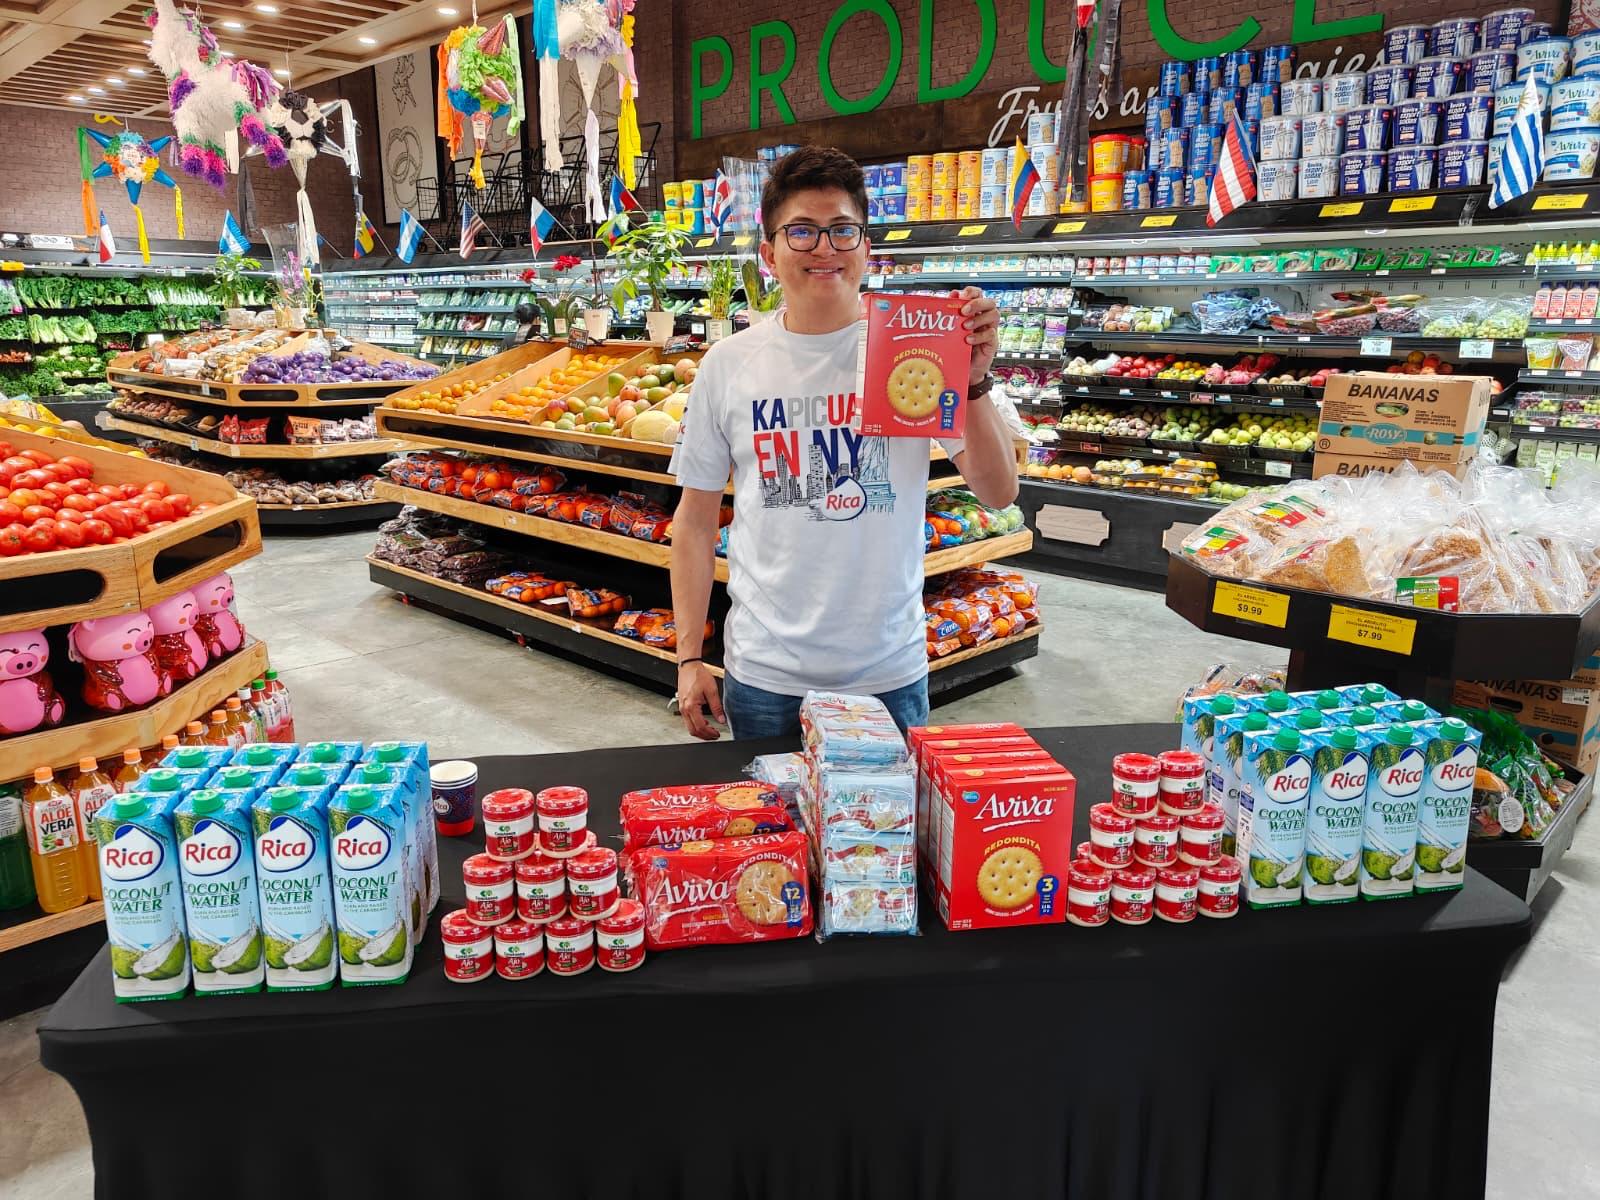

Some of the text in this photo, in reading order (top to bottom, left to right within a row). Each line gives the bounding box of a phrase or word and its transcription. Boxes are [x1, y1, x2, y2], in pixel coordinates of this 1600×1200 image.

[691, 0, 1384, 140] PRODU
[885, 303, 956, 332] Aviva
[893, 347, 944, 366] REDONDITA
[944, 392, 955, 406] 3
[1347, 383, 1440, 402] BANANAS
[1369, 428, 1401, 441] ROSY
[753, 427, 864, 479] EN NY
[826, 493, 861, 511] Rica
[1237, 603, 1263, 616] $9.99
[1357, 629, 1382, 641] $7.99
[1467, 680, 1560, 701] ANANAS
[1330, 772, 1366, 790] Rica
[1388, 767, 1422, 785] Rica
[1440, 764, 1474, 780] Rica
[1273, 772, 1309, 793] Rica
[973, 792, 1054, 820] Aviva
[1372, 801, 1417, 814] COCON
[1424, 796, 1469, 808] COCON
[41, 807, 72, 824] ALOE
[1259, 807, 1306, 820] COCON
[1315, 805, 1362, 818] COCON
[40, 817, 75, 835] VERA
[647, 825, 707, 845] Aviva
[185, 843, 232, 863] Rica
[261, 838, 306, 859] Rica
[337, 838, 382, 858] Rica
[984, 836, 1040, 856] REDONDITA
[106, 848, 153, 868] Rica
[340, 887, 388, 901] WATER
[650, 877, 730, 906] Aviva
[1042, 878, 1054, 892] 3
[111, 898, 163, 912] WATER
[190, 893, 241, 907] WATER
[265, 890, 313, 903] WATER
